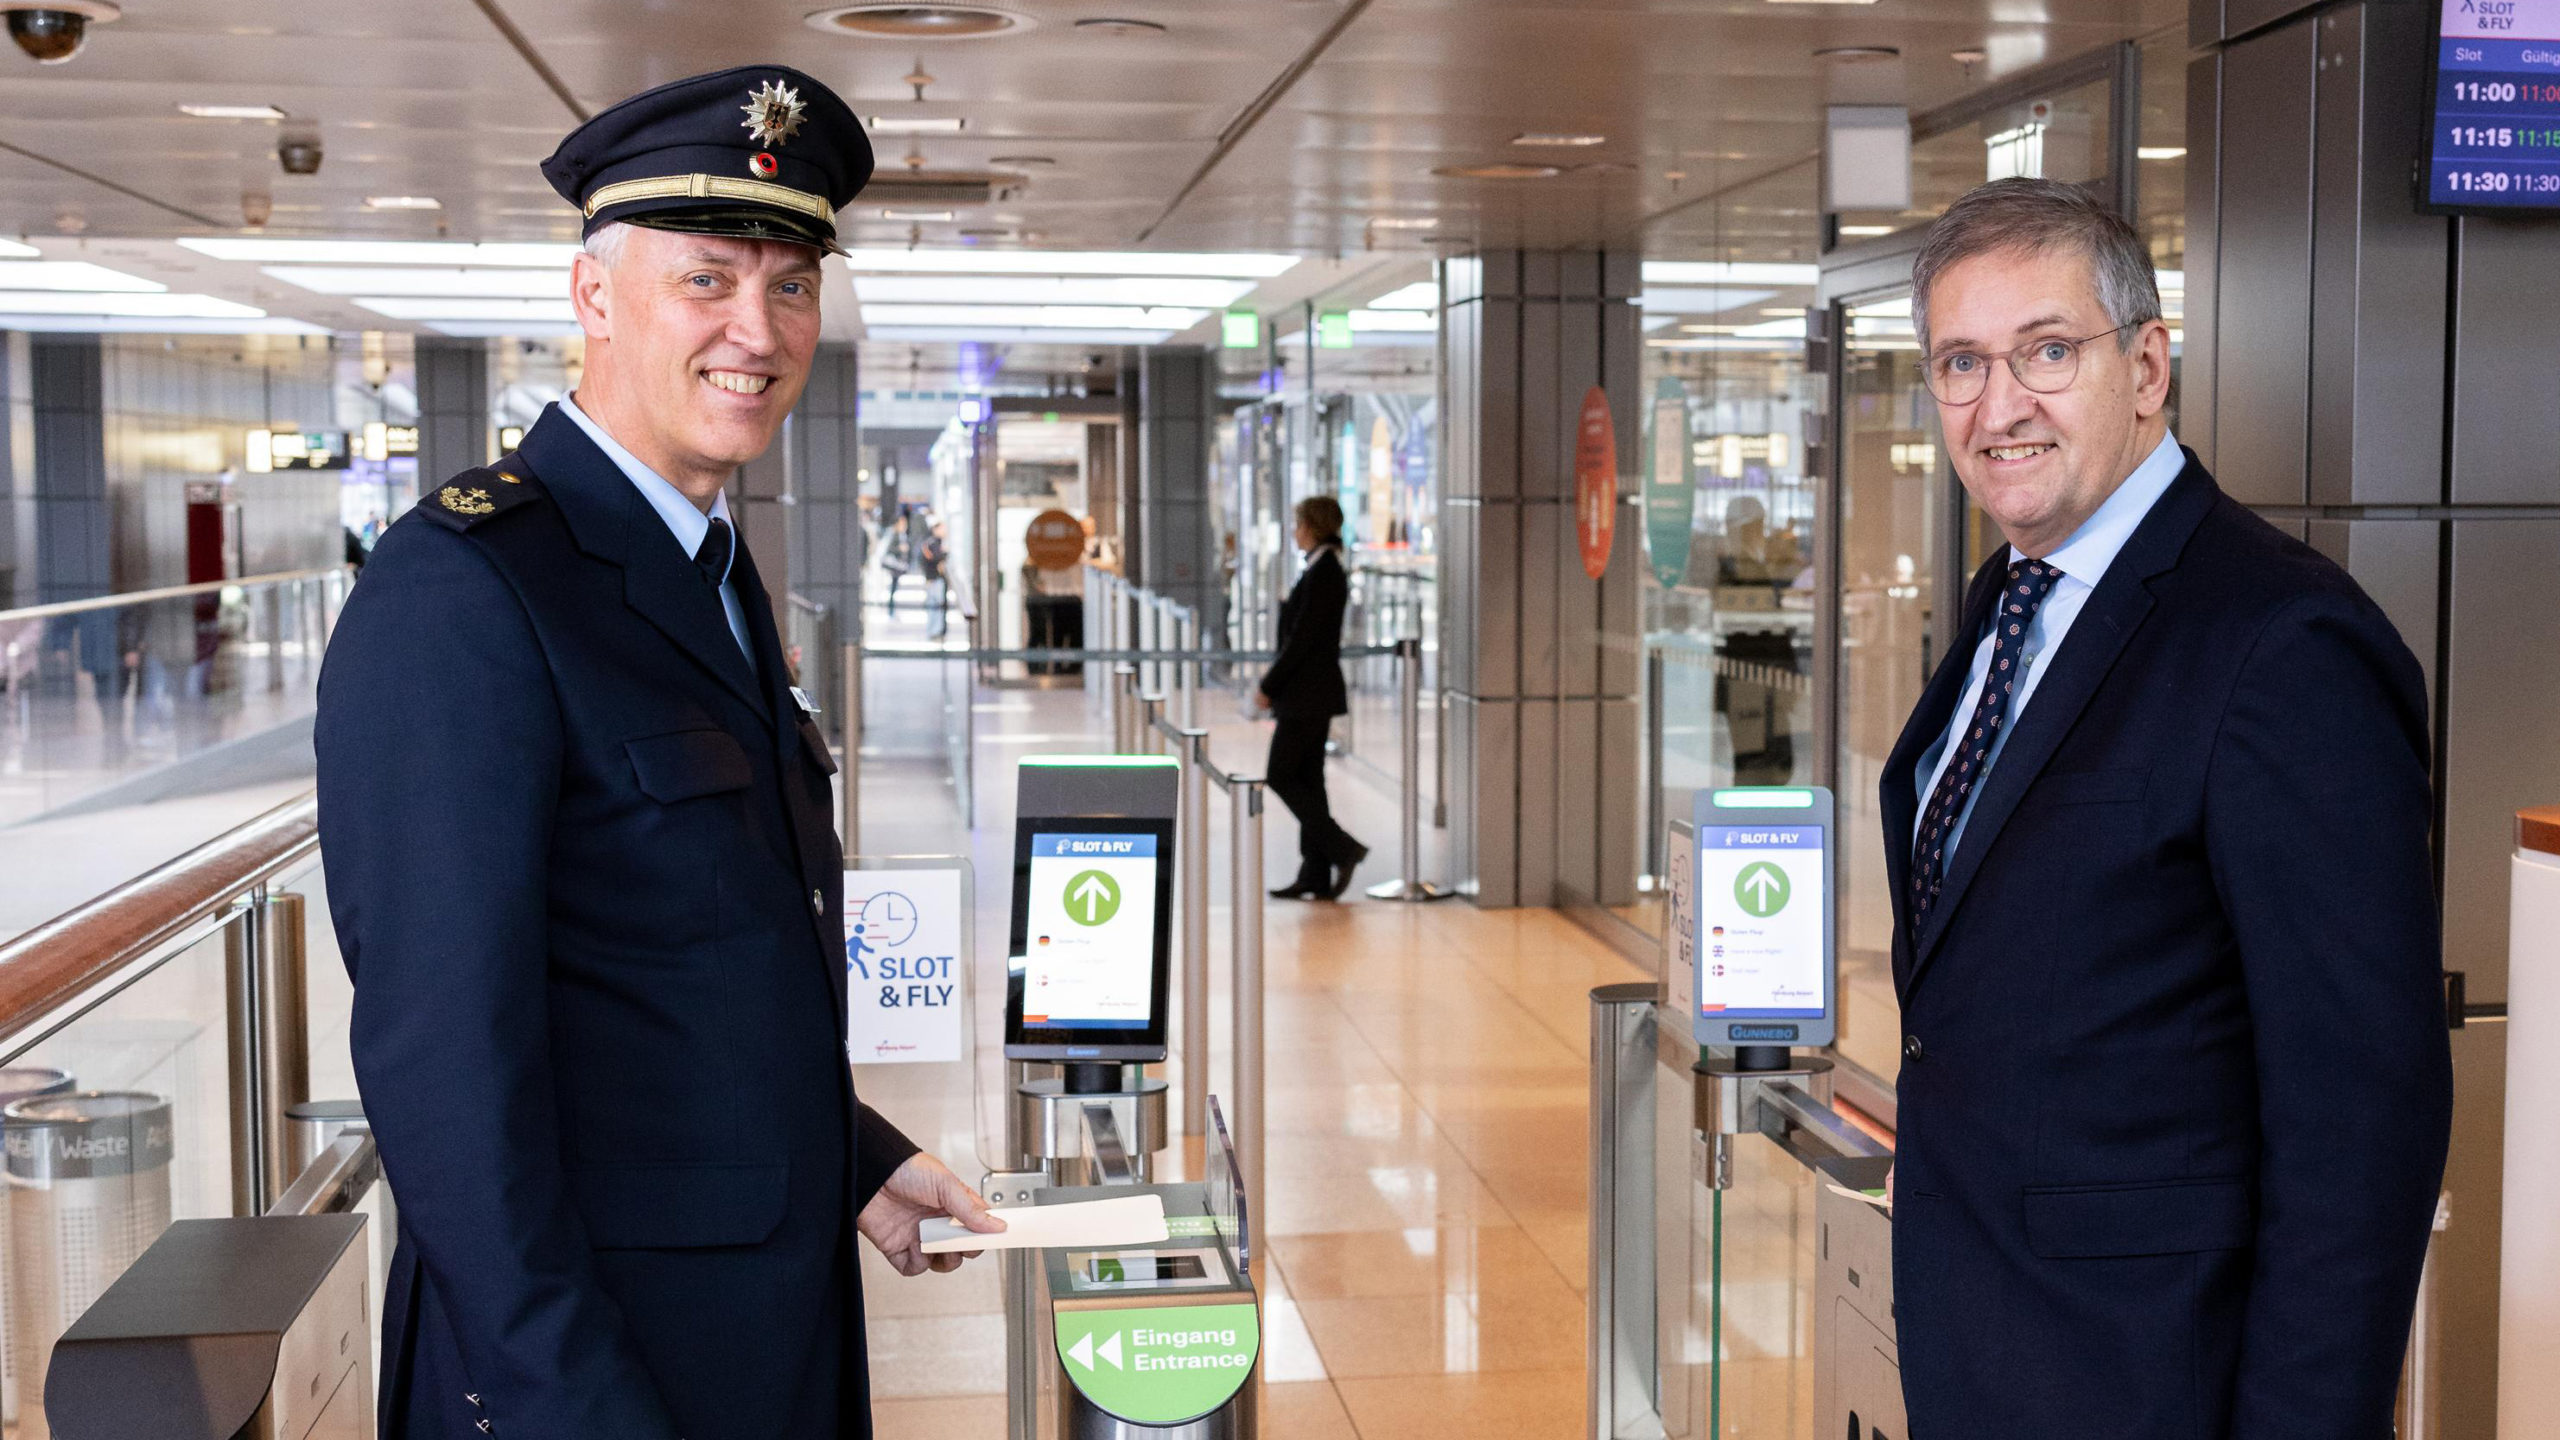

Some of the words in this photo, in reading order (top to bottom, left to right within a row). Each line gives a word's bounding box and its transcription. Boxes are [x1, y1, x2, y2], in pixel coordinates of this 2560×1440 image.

[2478, 3, 2515, 15] SLOT
[2478, 18, 2489, 29] &
[2490, 17, 2515, 29] FLY
[2455, 48, 2482, 61] Slot
[2454, 82, 2516, 102] 11:00
[2451, 127, 2512, 147] 11:15
[2517, 129, 2560, 147] 11:15
[2448, 172, 2509, 191] 11:30
[2513, 174, 2560, 192] 11:30
[1071, 841, 1102, 852] SLOT
[1102, 841, 1112, 852] &
[1113, 842, 1133, 852] FLY
[1740, 833, 1768, 844] SLOT
[1770, 833, 1779, 844] &
[1780, 833, 1799, 844] FLY
[879, 956, 954, 980] SLOT
[879, 986, 901, 1008] &
[907, 985, 954, 1007] FLY
[59, 1135, 129, 1160] Waste
[1132, 1329, 1236, 1348] Eingang
[1134, 1353, 1248, 1372] Entrance
